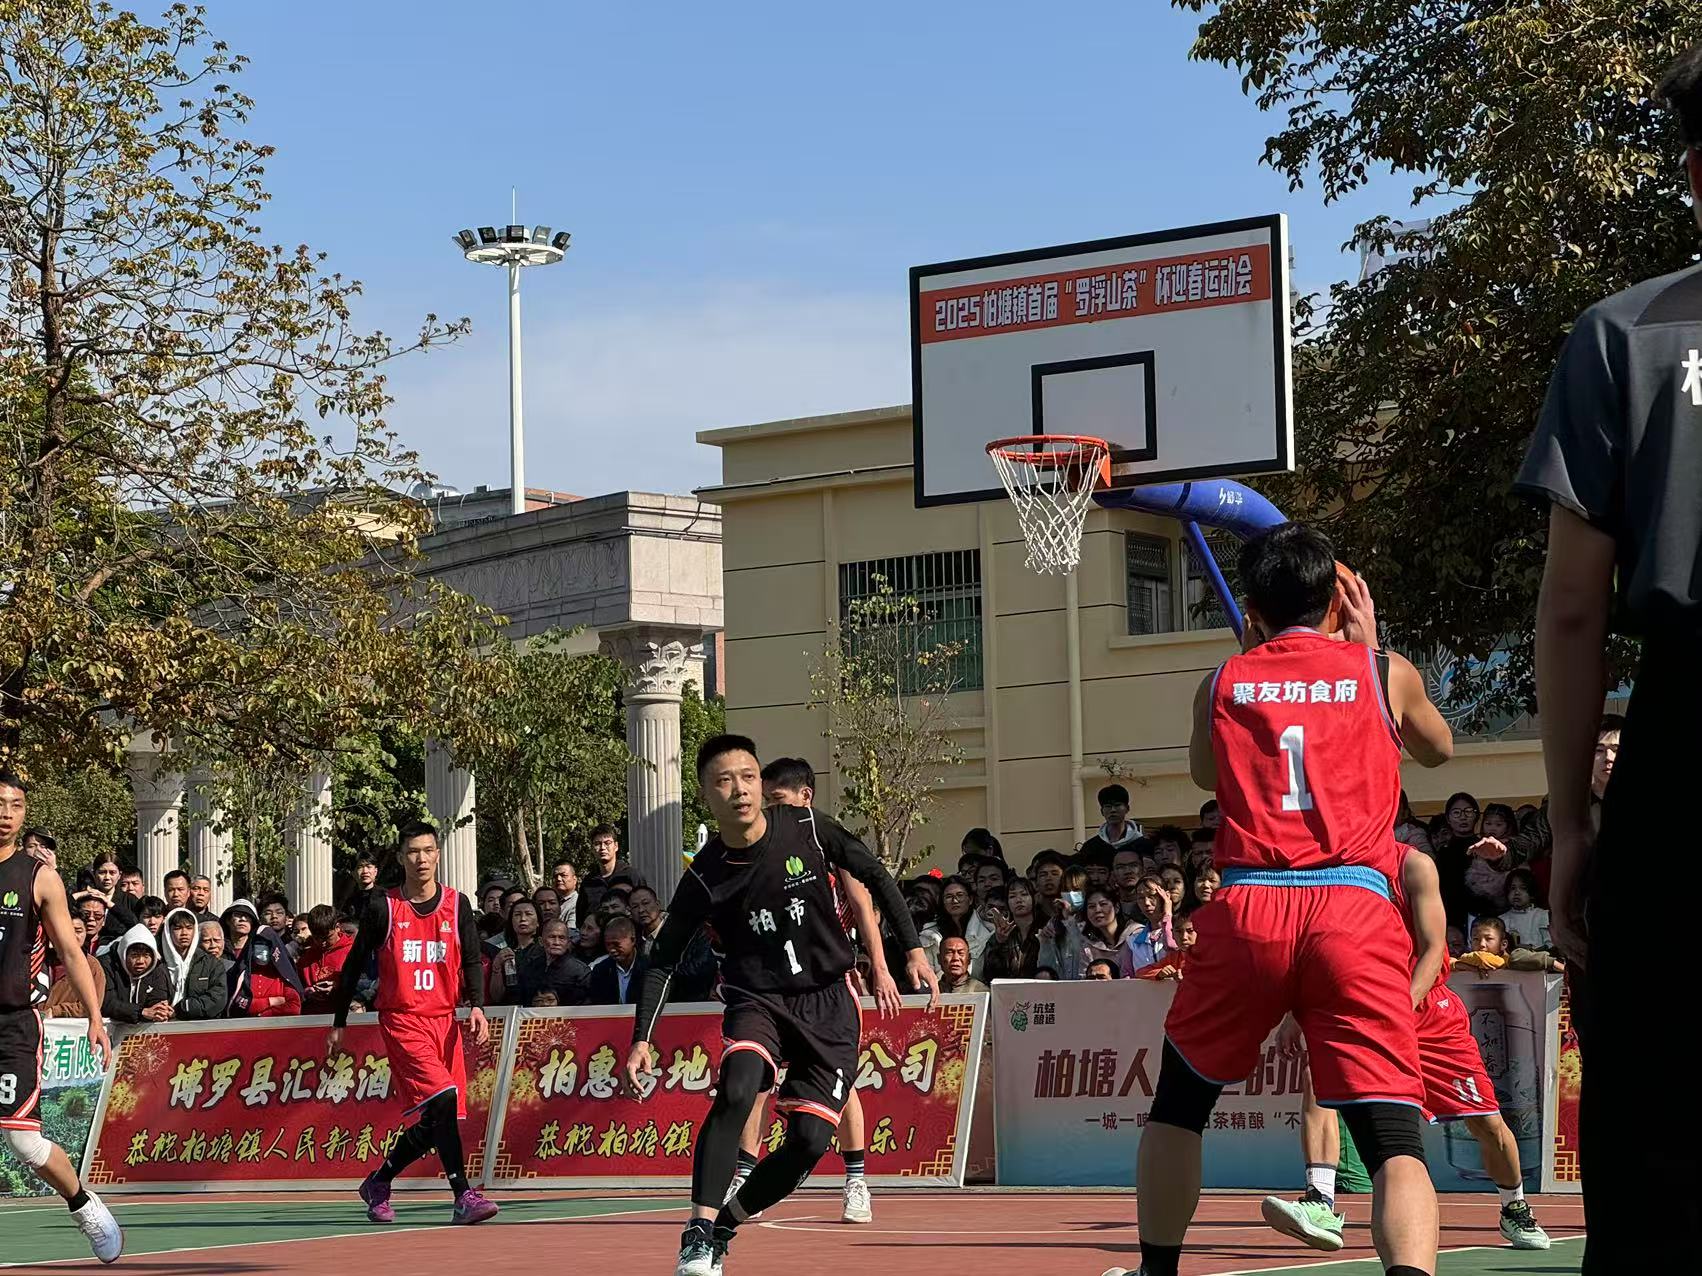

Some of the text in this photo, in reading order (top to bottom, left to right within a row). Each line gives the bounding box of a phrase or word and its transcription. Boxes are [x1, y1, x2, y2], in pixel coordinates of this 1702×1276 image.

[1233, 679, 1358, 705] 聚友坊食府
[1279, 725, 1314, 812] 1
[784, 939, 802, 975] 1
[413, 969, 434, 991] 10
[168, 1052, 396, 1109] 博罗县汇海酒
[1452, 1075, 1483, 1103] 11
